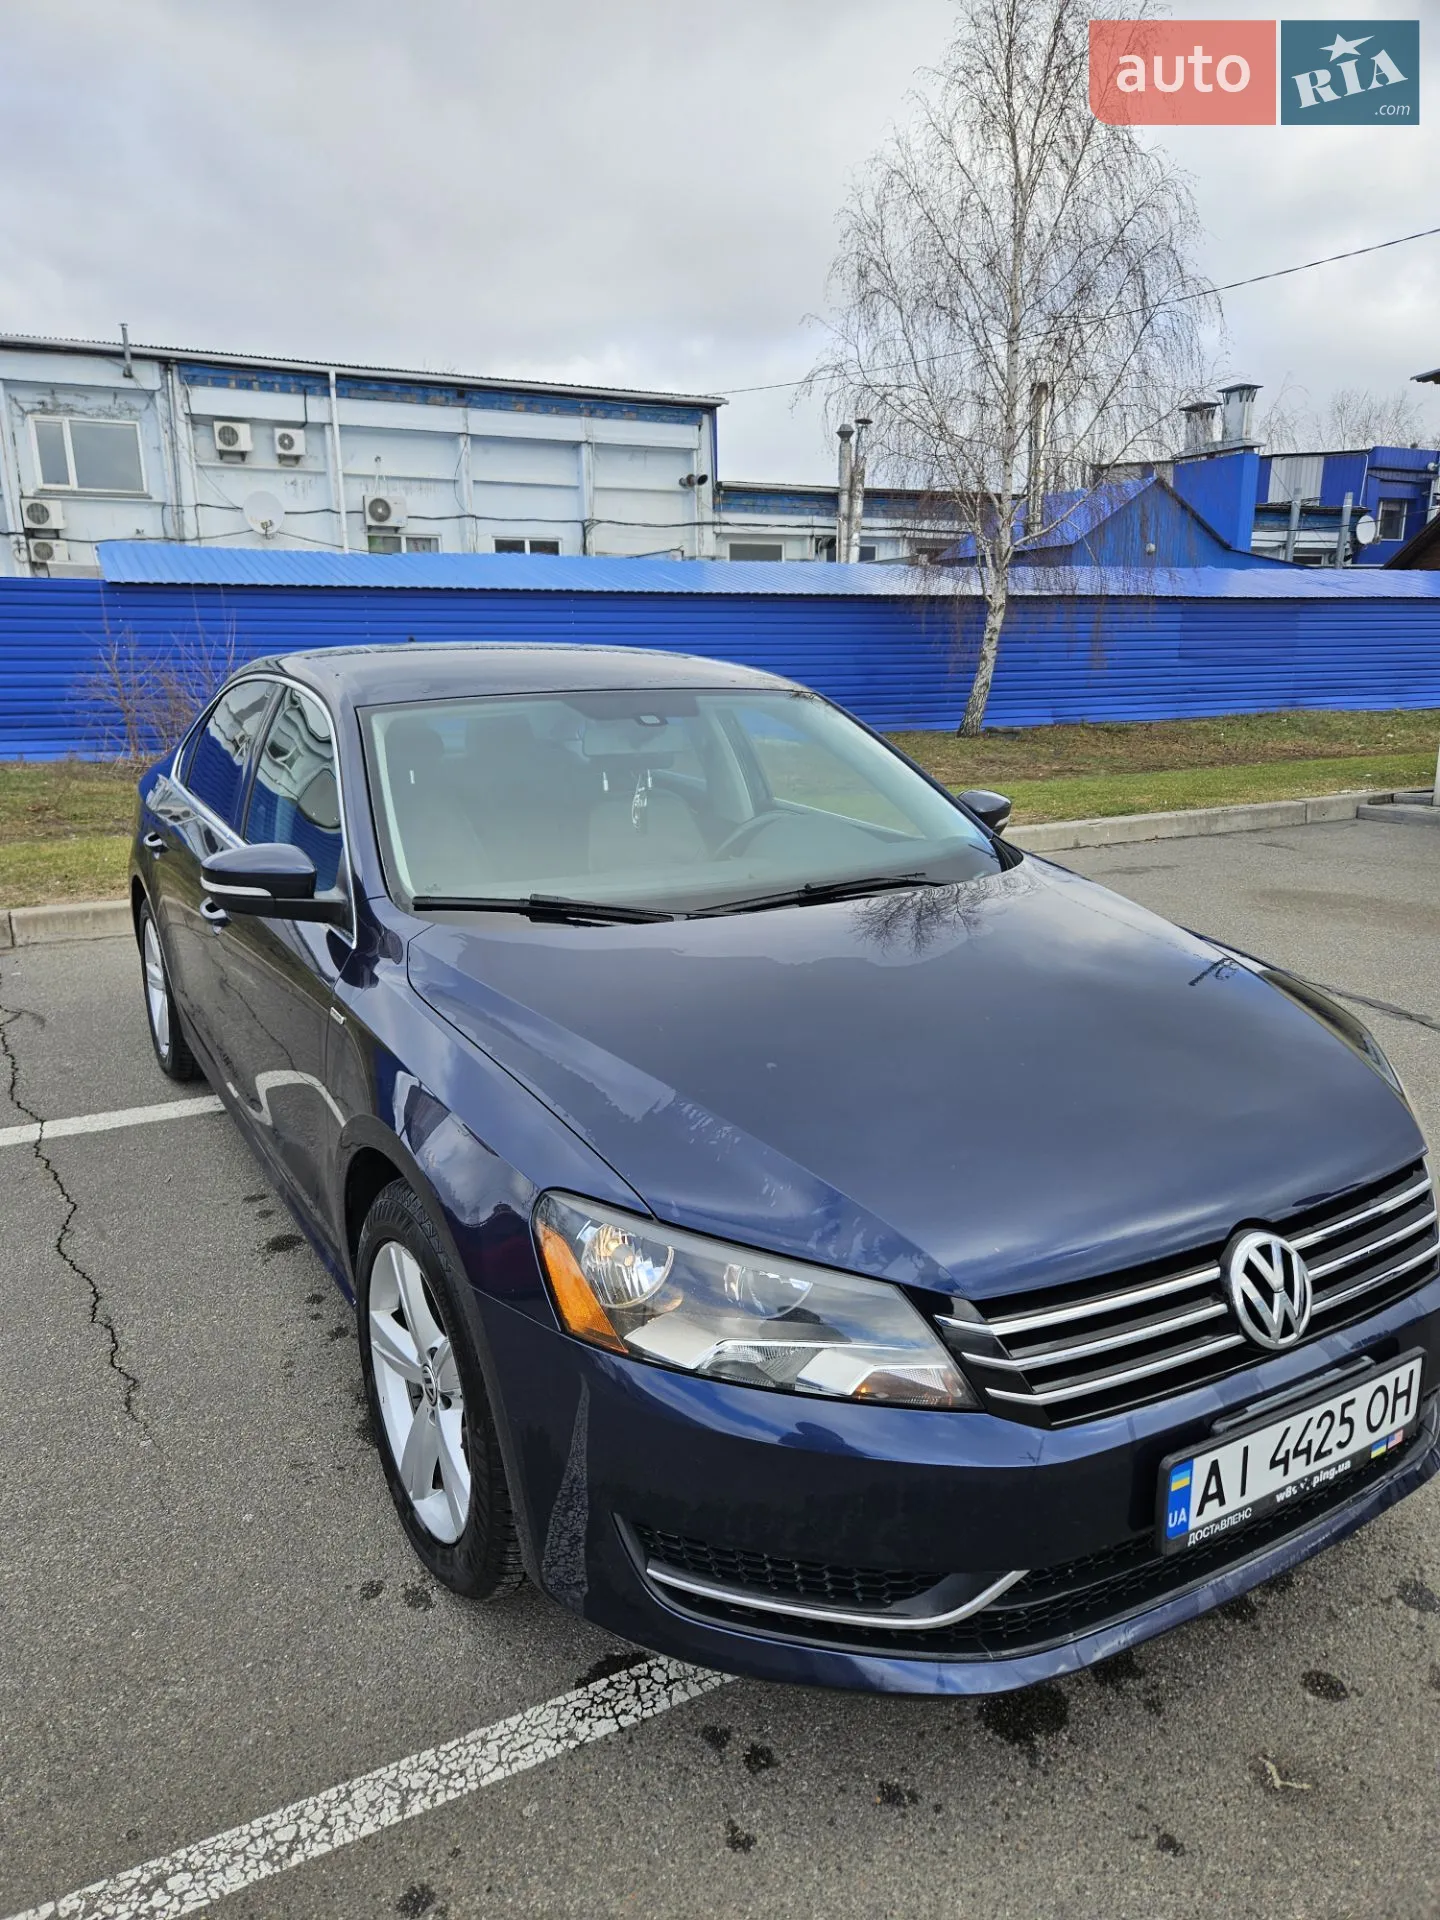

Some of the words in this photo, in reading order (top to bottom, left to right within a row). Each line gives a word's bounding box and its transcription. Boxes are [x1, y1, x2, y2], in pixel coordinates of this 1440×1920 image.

[1196, 1445, 1249, 1518] AI
[1269, 1397, 1356, 1478] 4425
[1366, 1368, 1414, 1434] OH
[1168, 1508, 1188, 1529] UA
[1187, 1507, 1253, 1547] ДОСТАВЛЕНО
